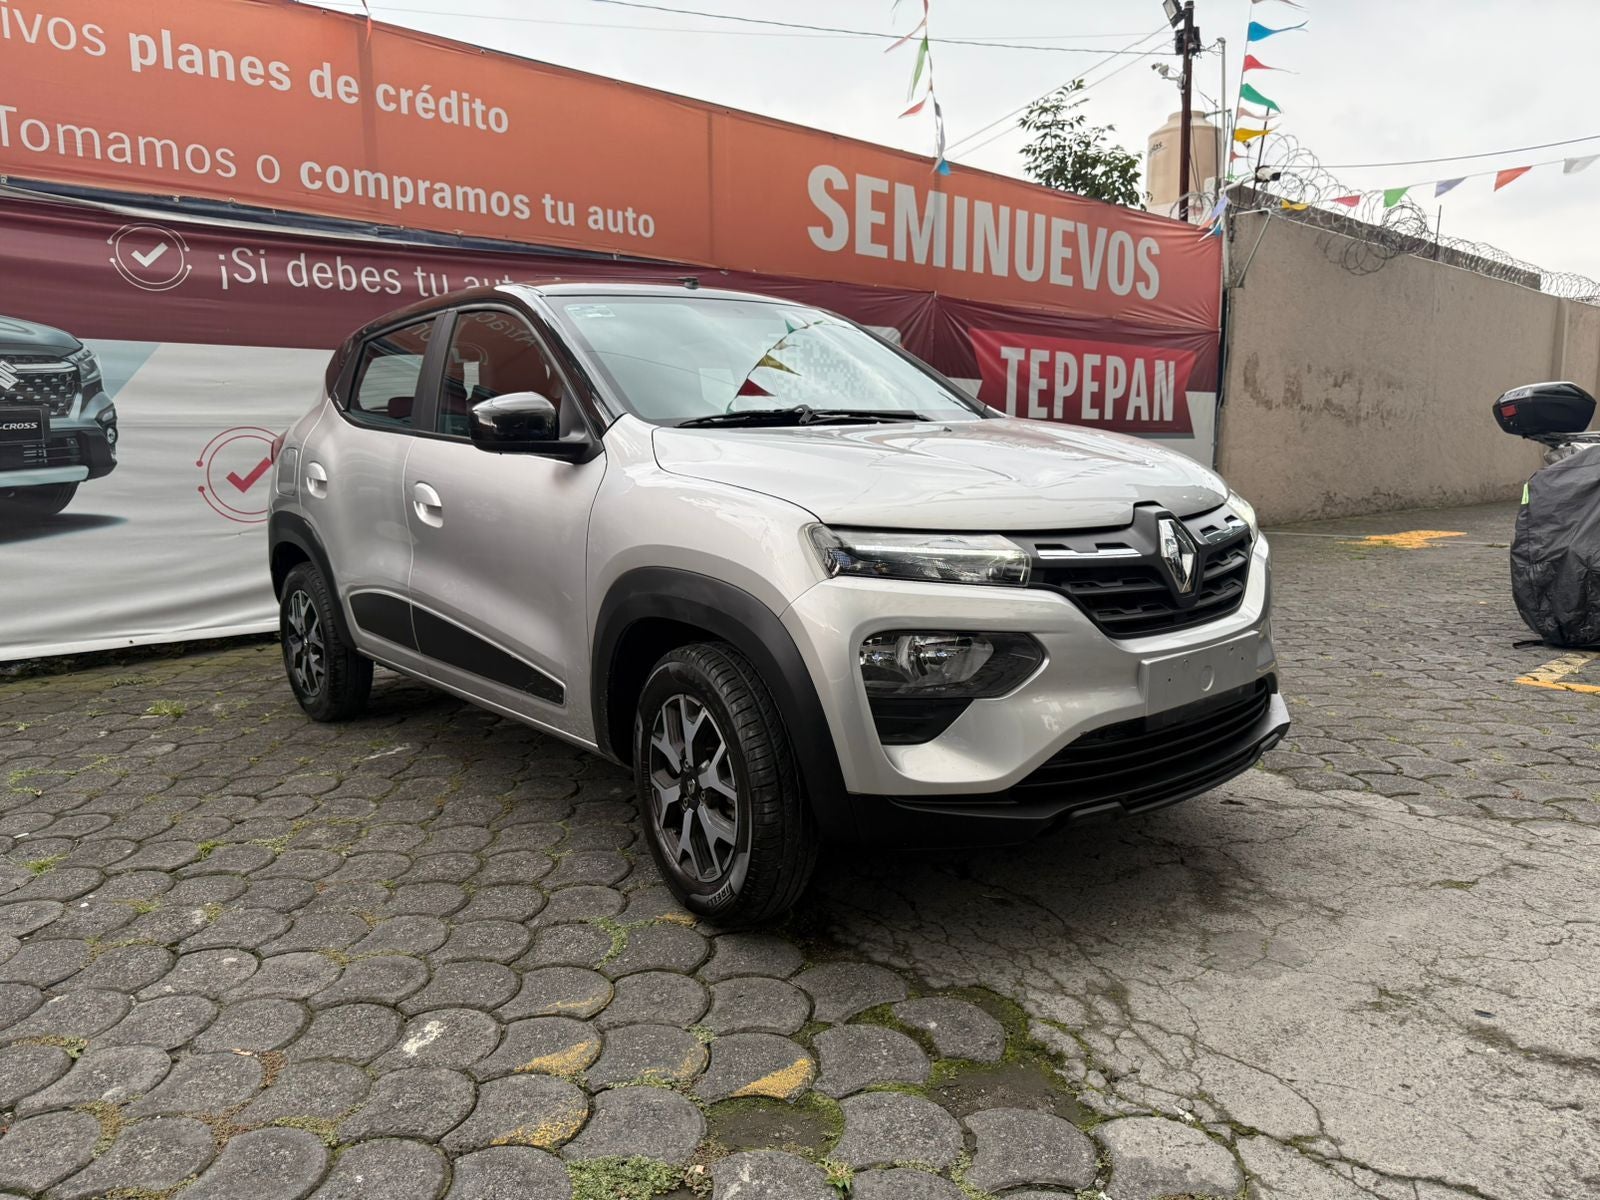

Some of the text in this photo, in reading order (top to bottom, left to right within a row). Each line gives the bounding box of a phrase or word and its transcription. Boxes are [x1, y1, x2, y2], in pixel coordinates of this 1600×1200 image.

[128, 31, 291, 92] planes
[309, 62, 360, 105] de
[375, 84, 509, 135] crédito
[0, 104, 655, 239] Tomamos o compramos tu auto
[219, 247, 449, 297] ¡Si debes tu
[807, 165, 1161, 301] SEMINUEVOS
[1000, 345, 1176, 422] TEPEPAN
